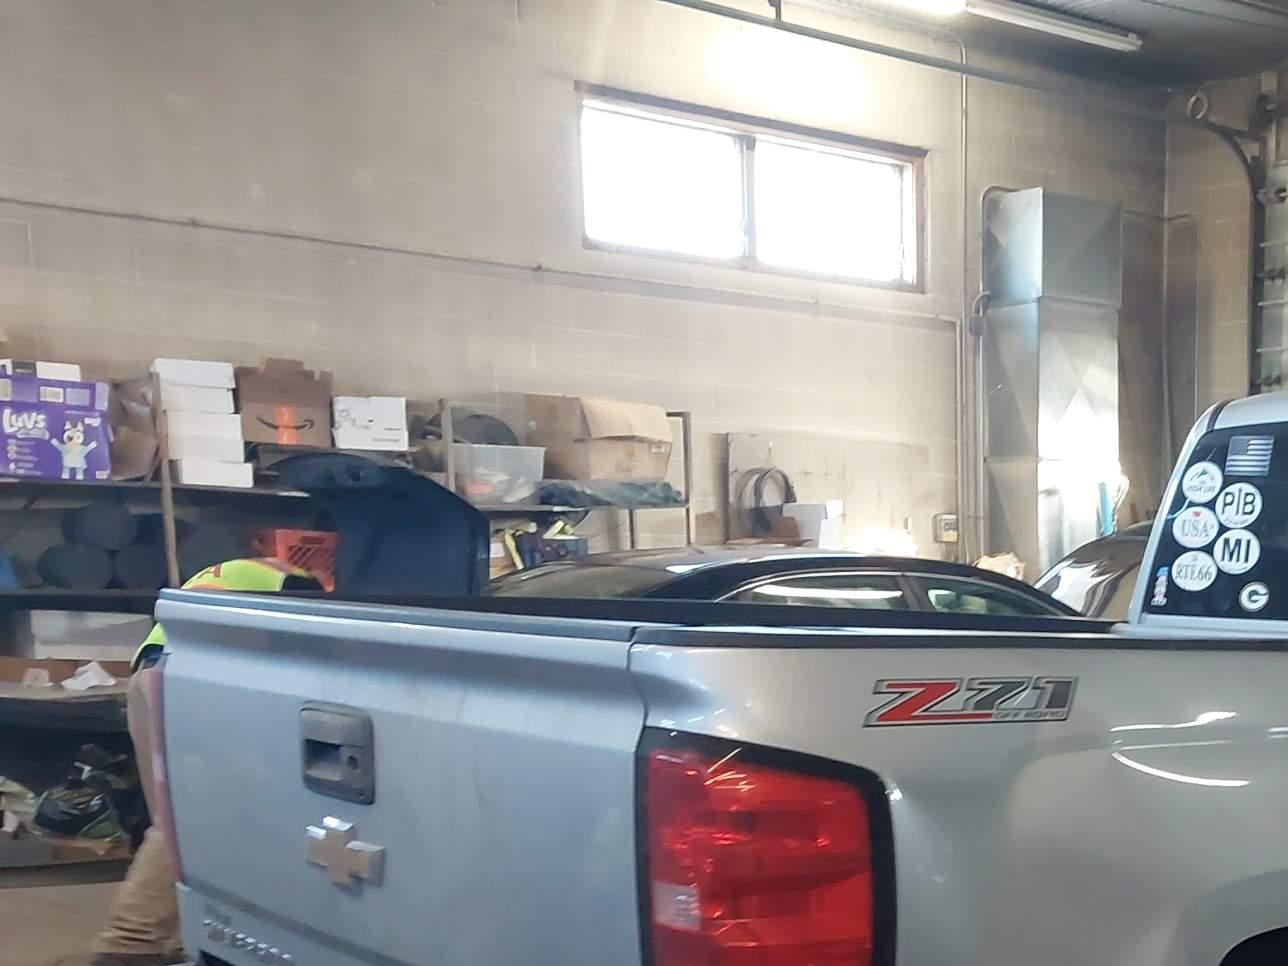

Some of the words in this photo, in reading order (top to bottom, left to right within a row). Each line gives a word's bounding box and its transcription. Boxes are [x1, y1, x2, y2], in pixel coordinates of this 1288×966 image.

[1181, 518, 1210, 538] USA
[1220, 537, 1251, 564] MI
[863, 677, 1079, 728] Z71
